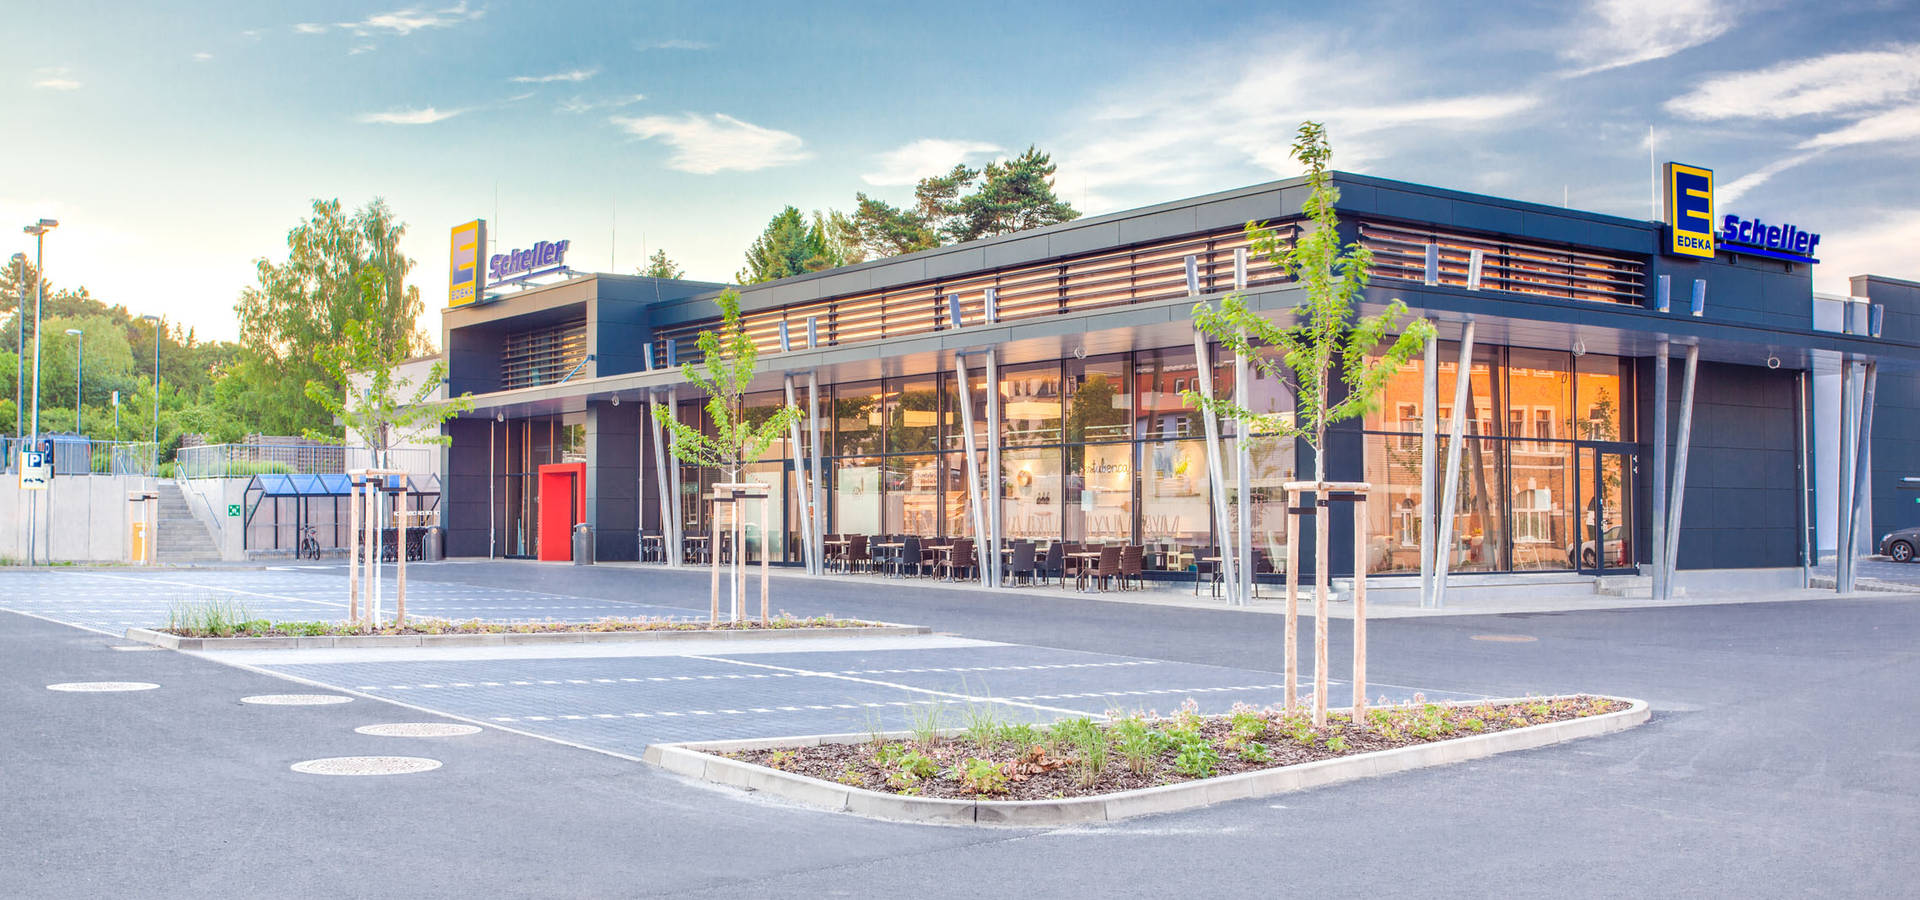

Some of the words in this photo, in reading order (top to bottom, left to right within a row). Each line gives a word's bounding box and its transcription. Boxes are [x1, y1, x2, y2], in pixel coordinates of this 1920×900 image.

[1676, 171, 1710, 235] E
[1677, 235, 1711, 250] EDEKA
[1722, 214, 1821, 253] Scheller
[452, 229, 475, 285] E
[488, 240, 570, 279] Scheller
[451, 286, 474, 300] EDEKA
[30, 454, 40, 467] P
